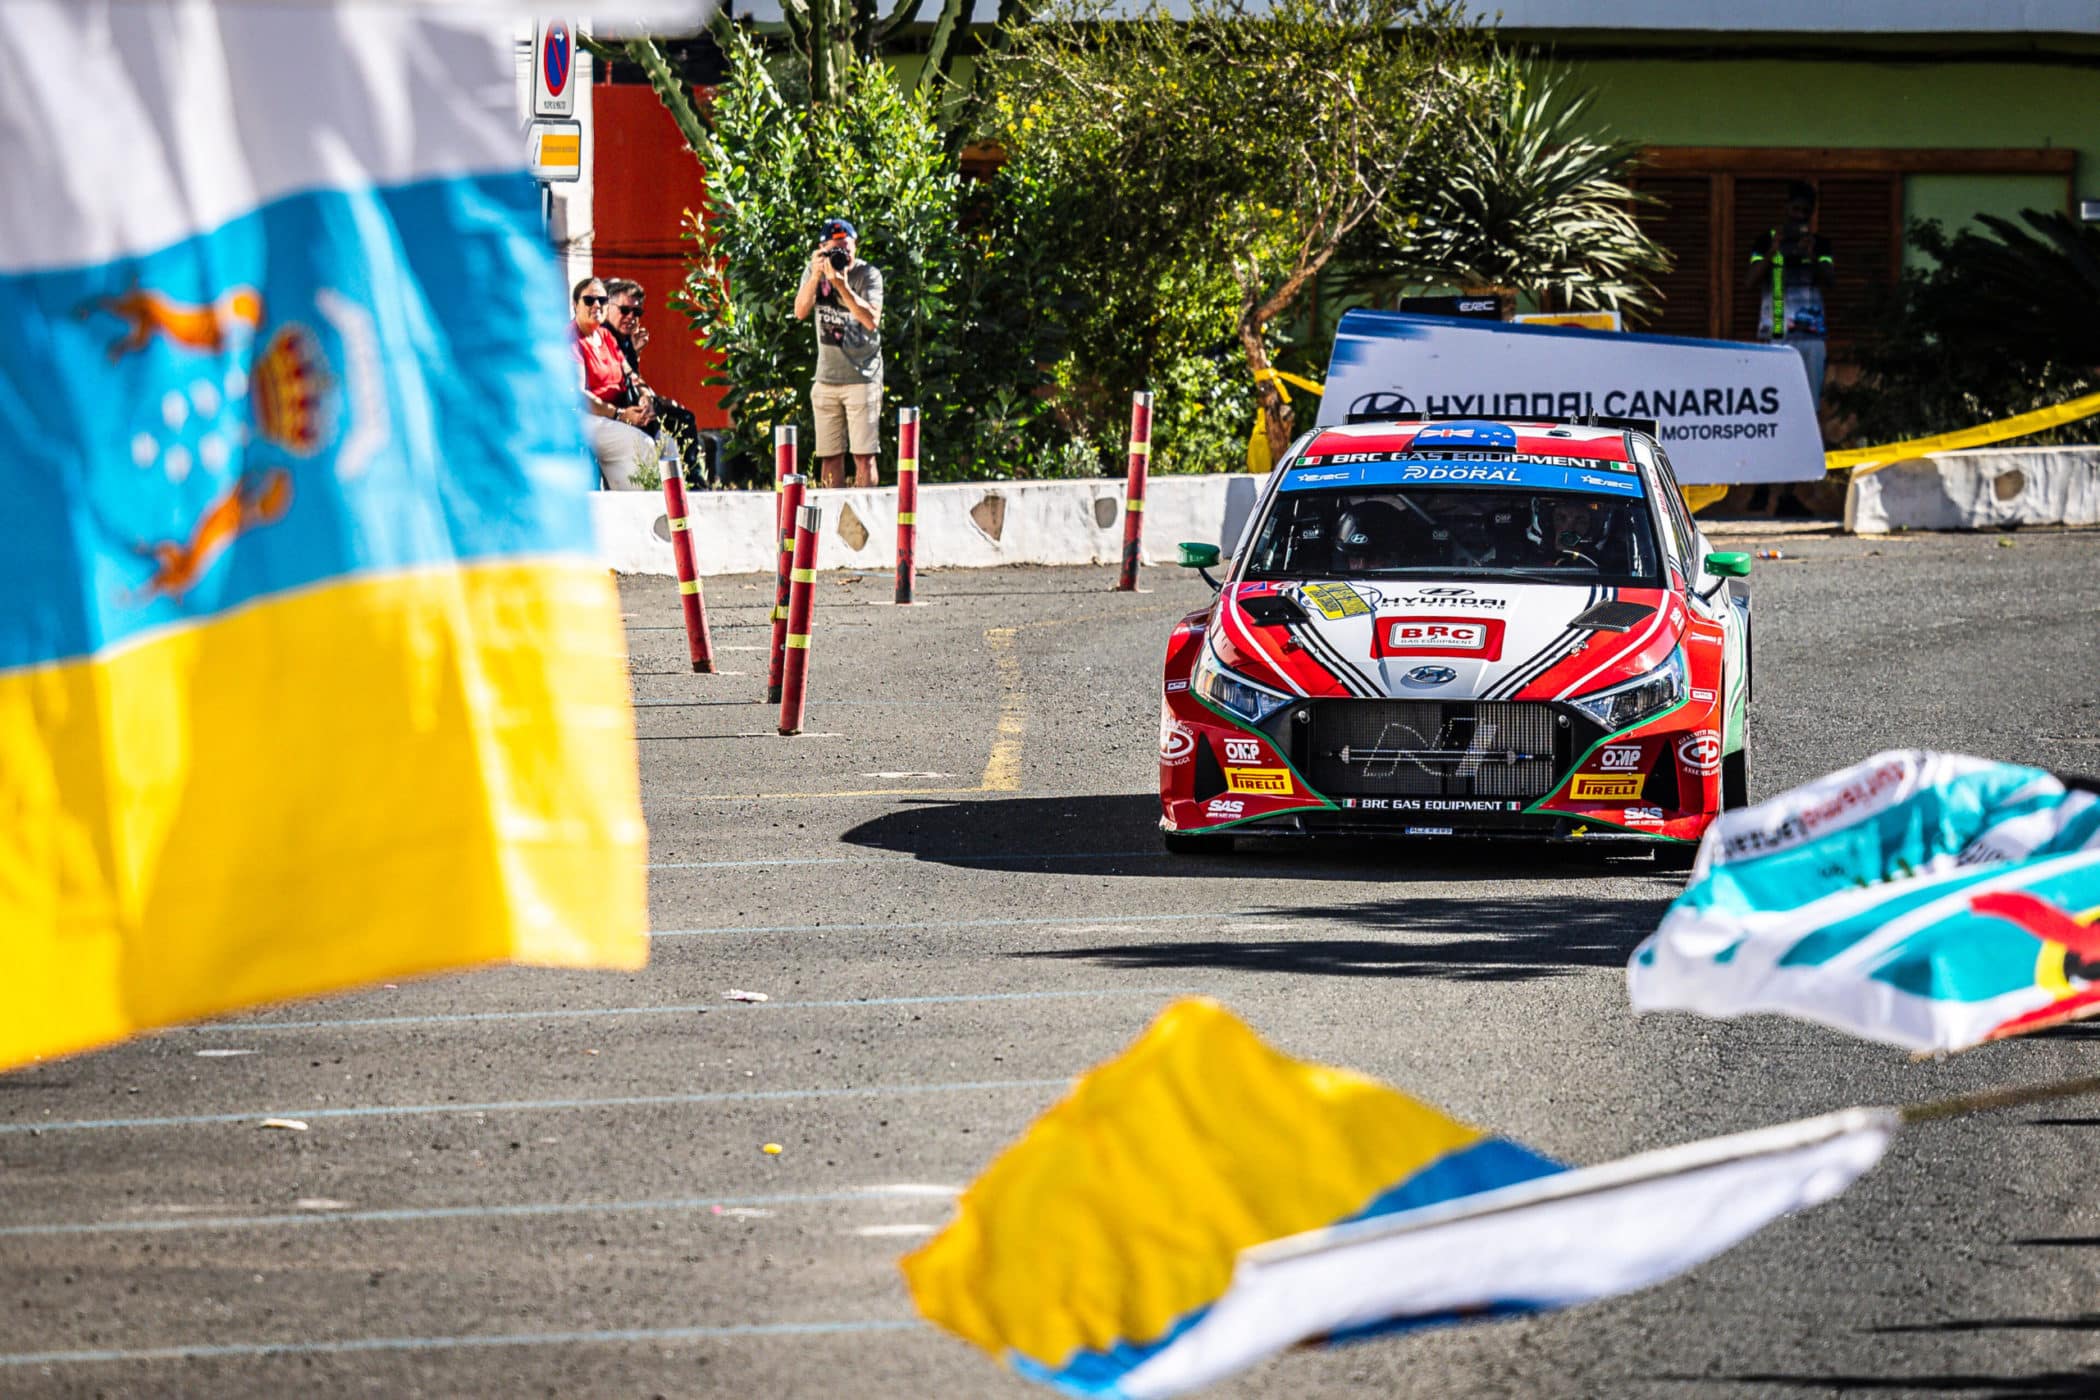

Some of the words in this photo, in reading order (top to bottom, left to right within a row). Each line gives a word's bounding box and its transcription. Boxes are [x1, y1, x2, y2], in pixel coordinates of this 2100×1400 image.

[1426, 391, 1593, 416] HYUNDAI
[1604, 386, 1780, 418] CANARIAS
[1662, 423, 1778, 441] MOTORSPORT
[1331, 453, 1383, 464] BRC
[1390, 452, 1444, 462] GAS
[1452, 453, 1601, 468] EQUIPMENT
[1429, 468, 1521, 482] DORAL
[1382, 597, 1507, 606] HYUNDAI
[1401, 626, 1475, 640] BRC
[1225, 743, 1260, 760] OMP
[1602, 750, 1641, 766] OMP
[1231, 773, 1285, 790] PIRELLI
[1577, 779, 1638, 795] PIRELLI
[1207, 799, 1245, 813] SAS
[1362, 799, 1389, 809] BRC
[1393, 800, 1421, 809] GAS
[1425, 800, 1502, 811] EQUIPMENT
[1623, 807, 1664, 819] SAS
